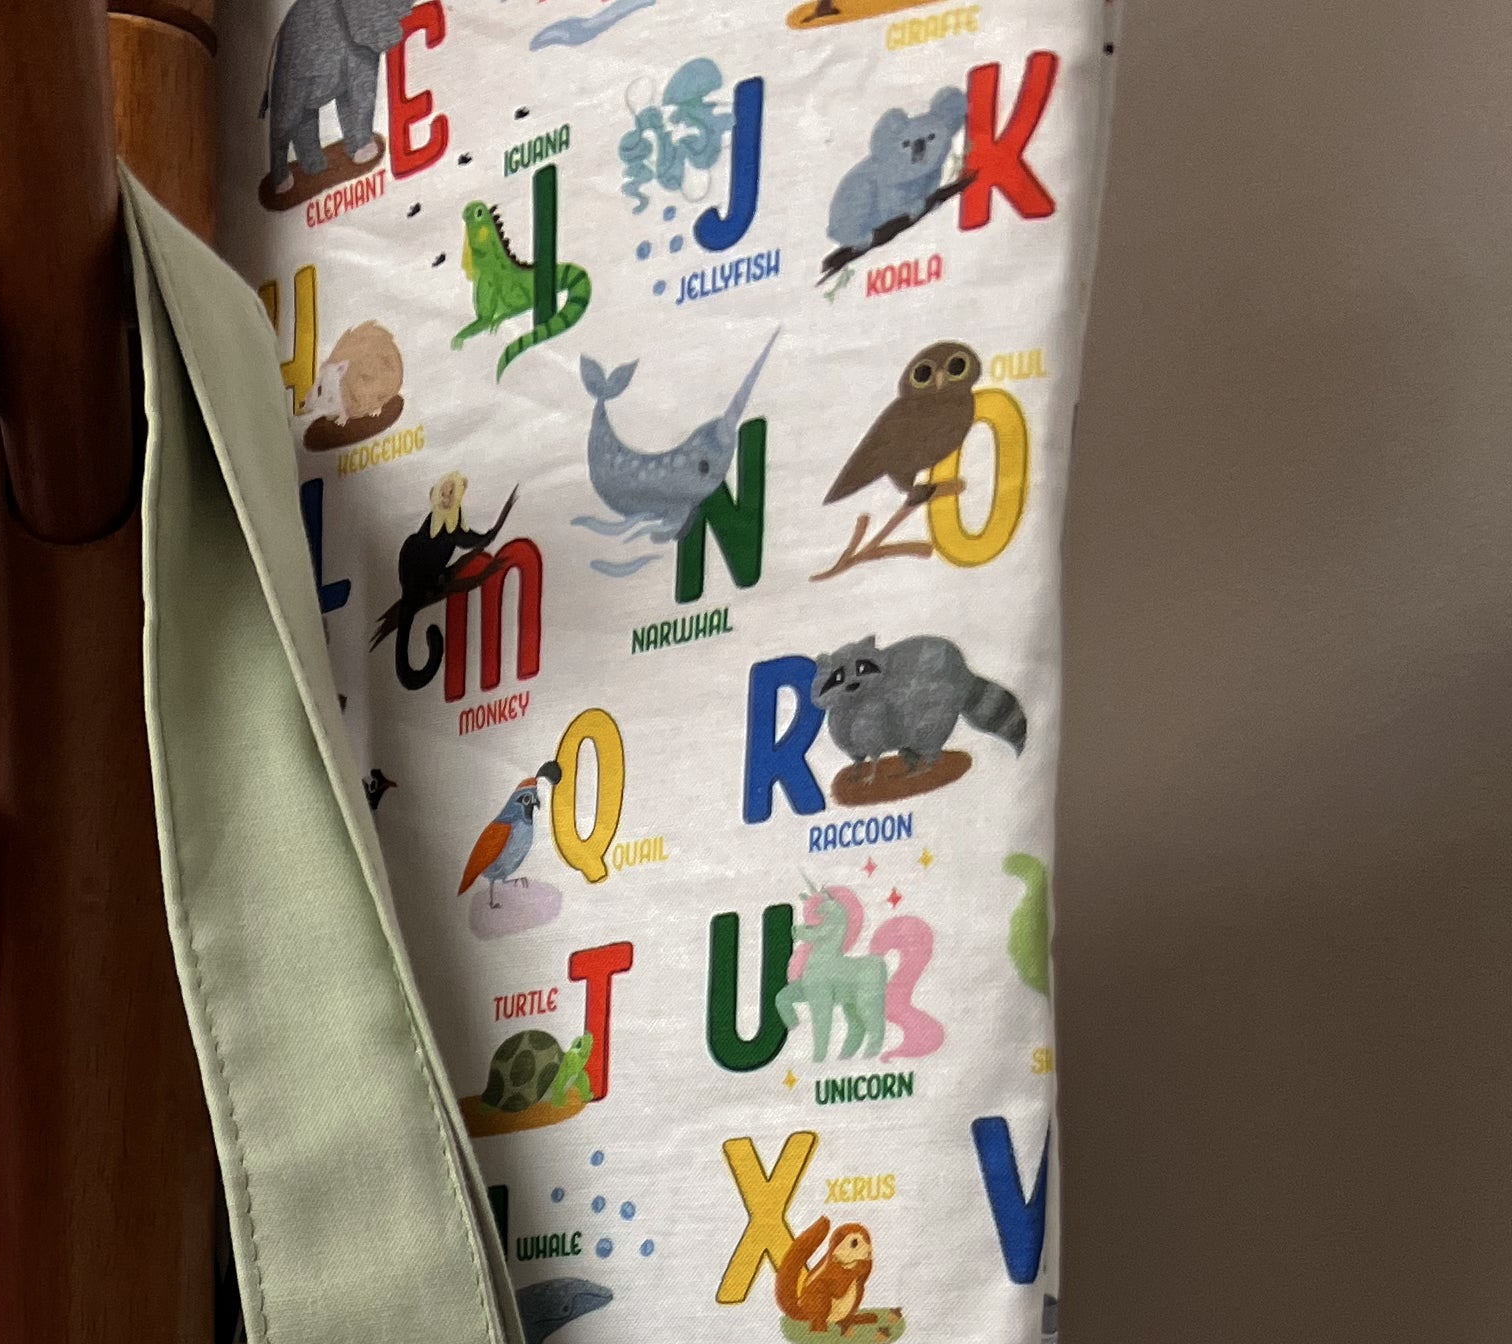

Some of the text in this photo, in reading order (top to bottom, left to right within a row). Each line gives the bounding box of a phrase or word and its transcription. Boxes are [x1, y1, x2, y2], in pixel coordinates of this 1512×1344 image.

[885, 4, 982, 51] GIRAFFE
[386, 0, 449, 180] E
[504, 123, 570, 177] IGUANA
[693, 76, 764, 252] J
[959, 50, 1059, 231] K
[306, 169, 385, 227] ELEPHANT
[533, 163, 558, 335] I
[675, 249, 780, 305] JELLYFISH
[866, 254, 943, 297] KOALA
[989, 348, 1047, 381] OWL
[337, 424, 426, 478] HEDGEHOG
[927, 388, 1028, 568] O
[675, 416, 766, 604] N
[631, 607, 733, 655] NARWHAL
[459, 691, 530, 736] MONKEY
[743, 655, 826, 824] R
[551, 708, 625, 883] Q
[612, 836, 668, 871] QUAIL
[809, 813, 912, 853] RACCOON
[494, 987, 559, 1022] TURTLE
[707, 903, 793, 1073] U
[568, 941, 633, 1103] T
[815, 1071, 914, 1105] UNICORN
[824, 1174, 896, 1204] XERUS
[970, 1116, 1051, 1285] V
[716, 1131, 817, 1304] X
[517, 1231, 582, 1261] WHALE
